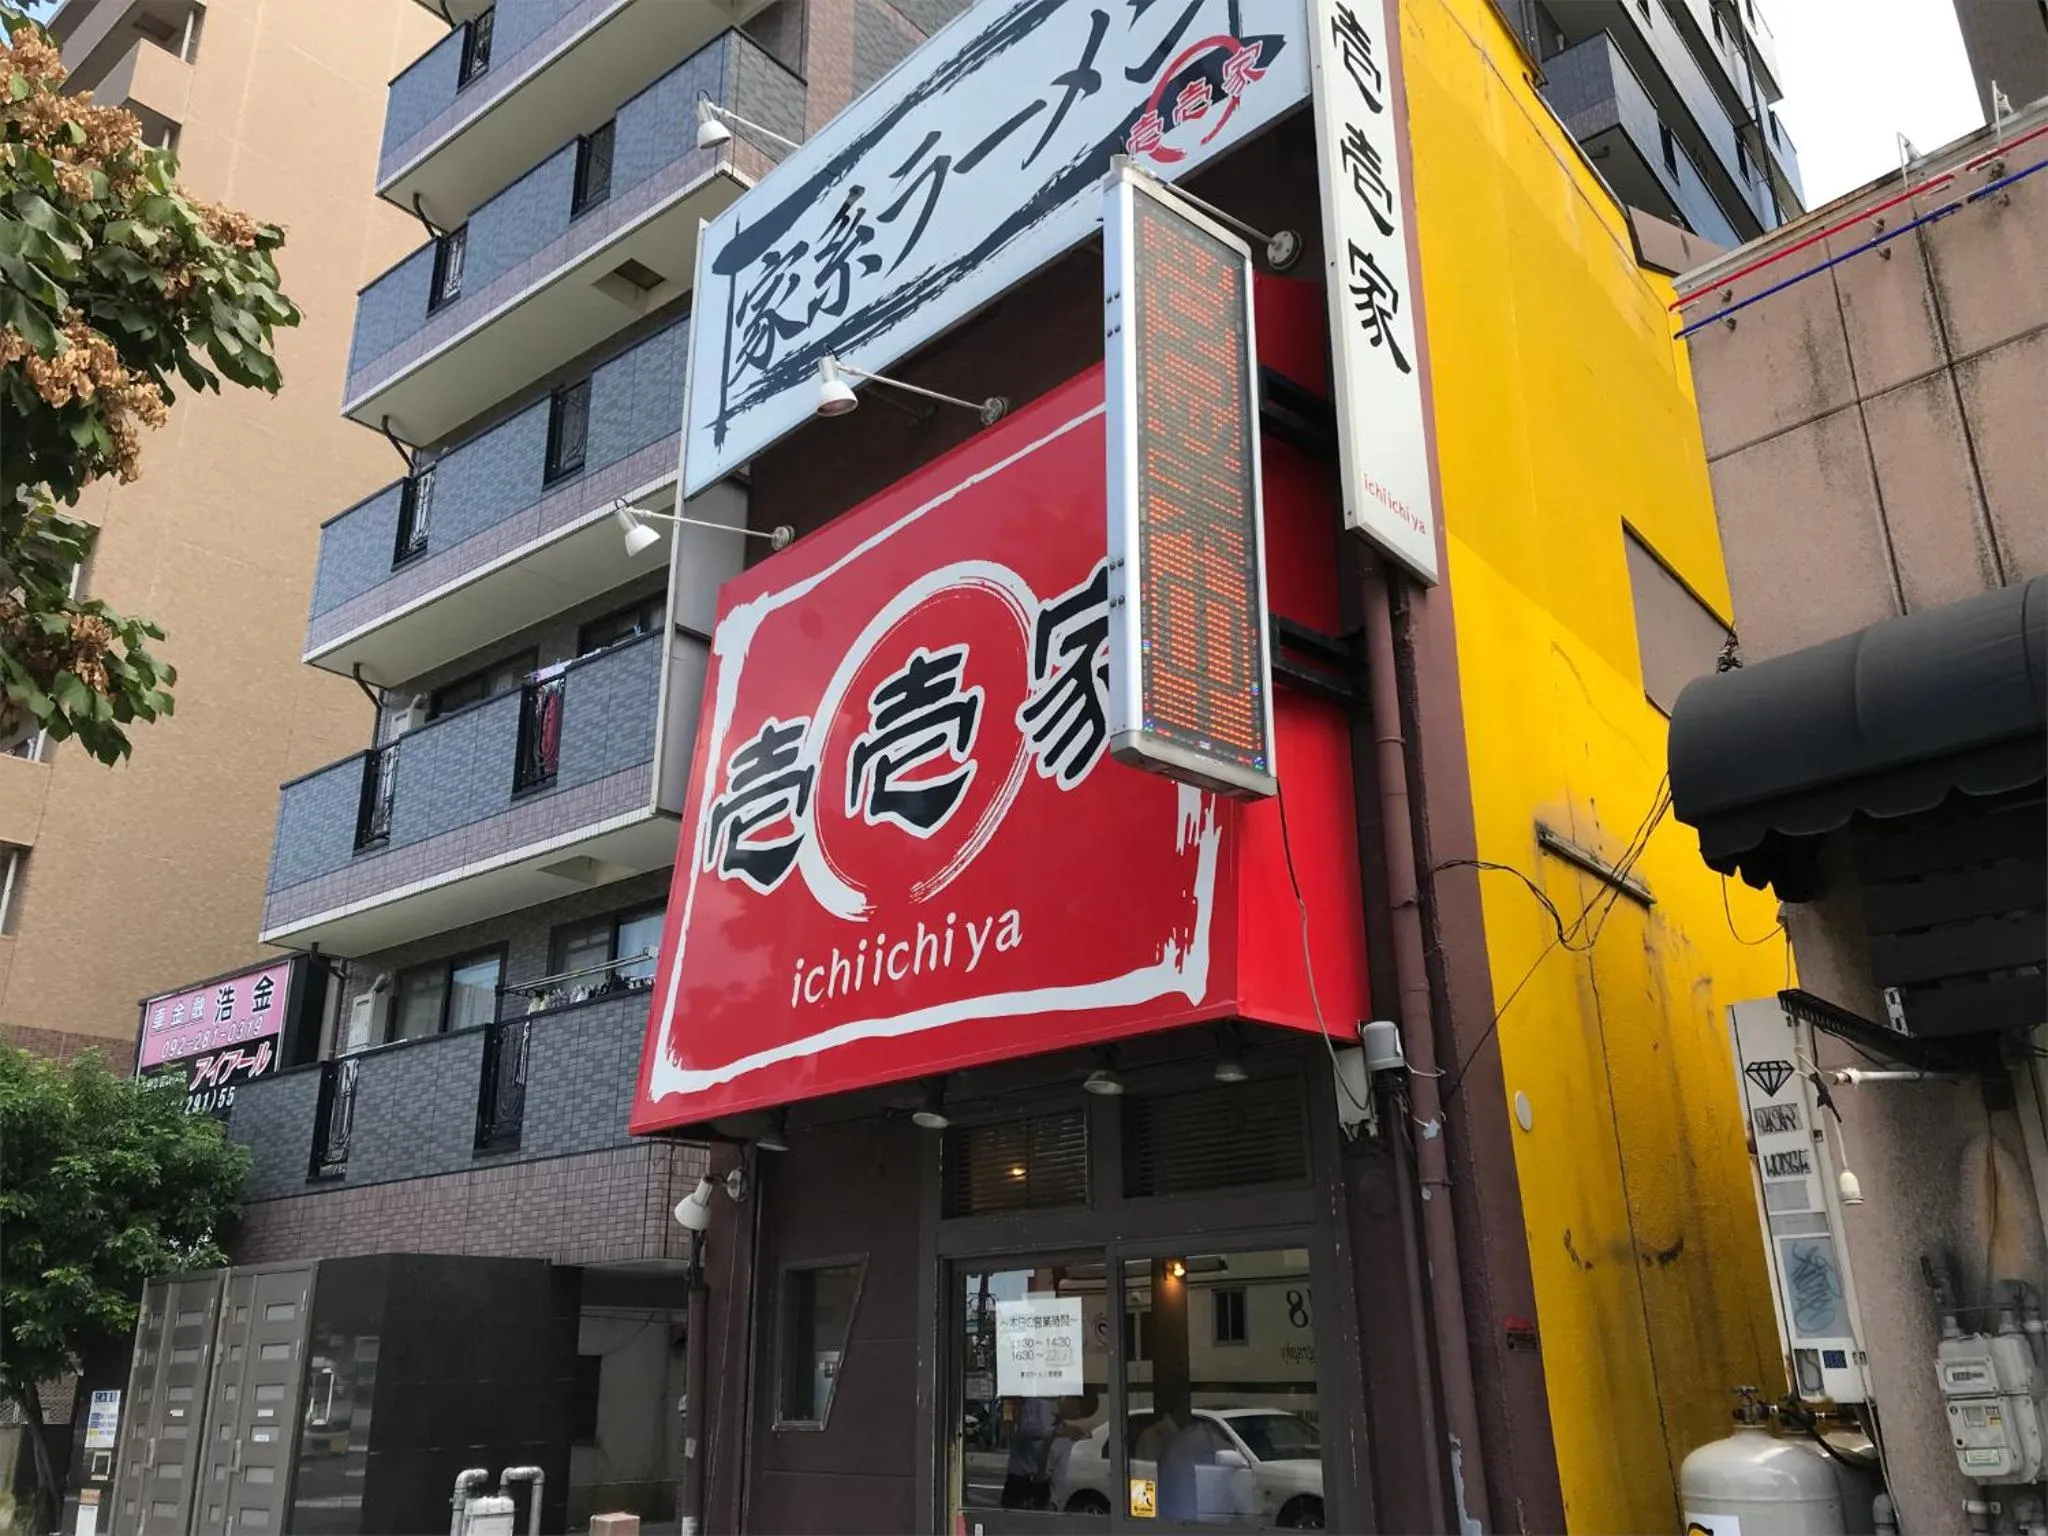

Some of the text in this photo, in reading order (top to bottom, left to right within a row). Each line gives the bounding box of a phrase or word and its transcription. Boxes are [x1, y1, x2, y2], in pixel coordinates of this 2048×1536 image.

[730, 0, 1204, 385] 家系ラーメン
[190, 1041, 272, 1091] アイアール
